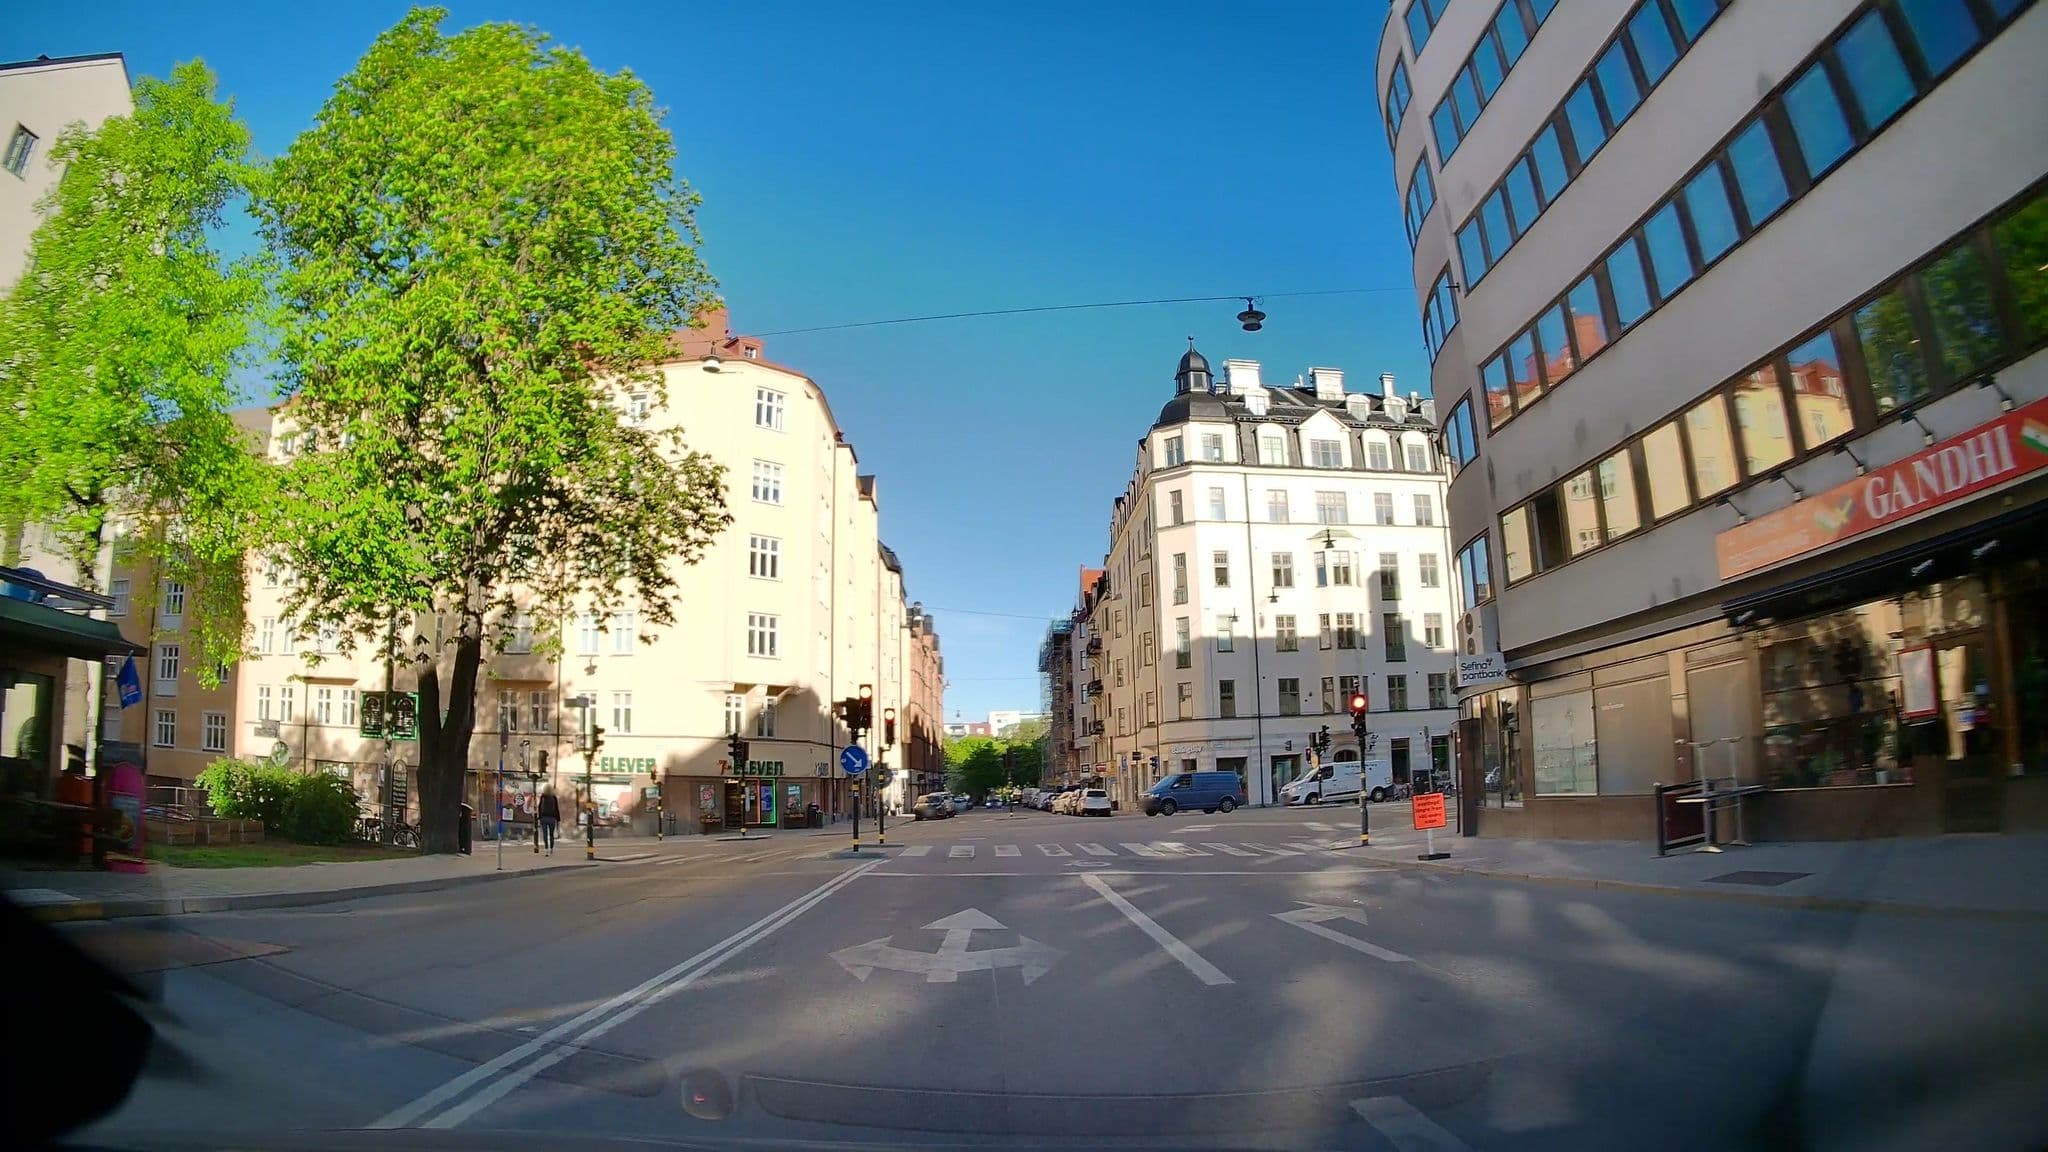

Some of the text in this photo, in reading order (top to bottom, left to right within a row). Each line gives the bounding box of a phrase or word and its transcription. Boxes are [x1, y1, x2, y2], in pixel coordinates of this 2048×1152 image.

[1864, 425, 2017, 519] GANDHI
[1461, 661, 1488, 671] Sefina
[1462, 669, 1504, 680] pantbank
